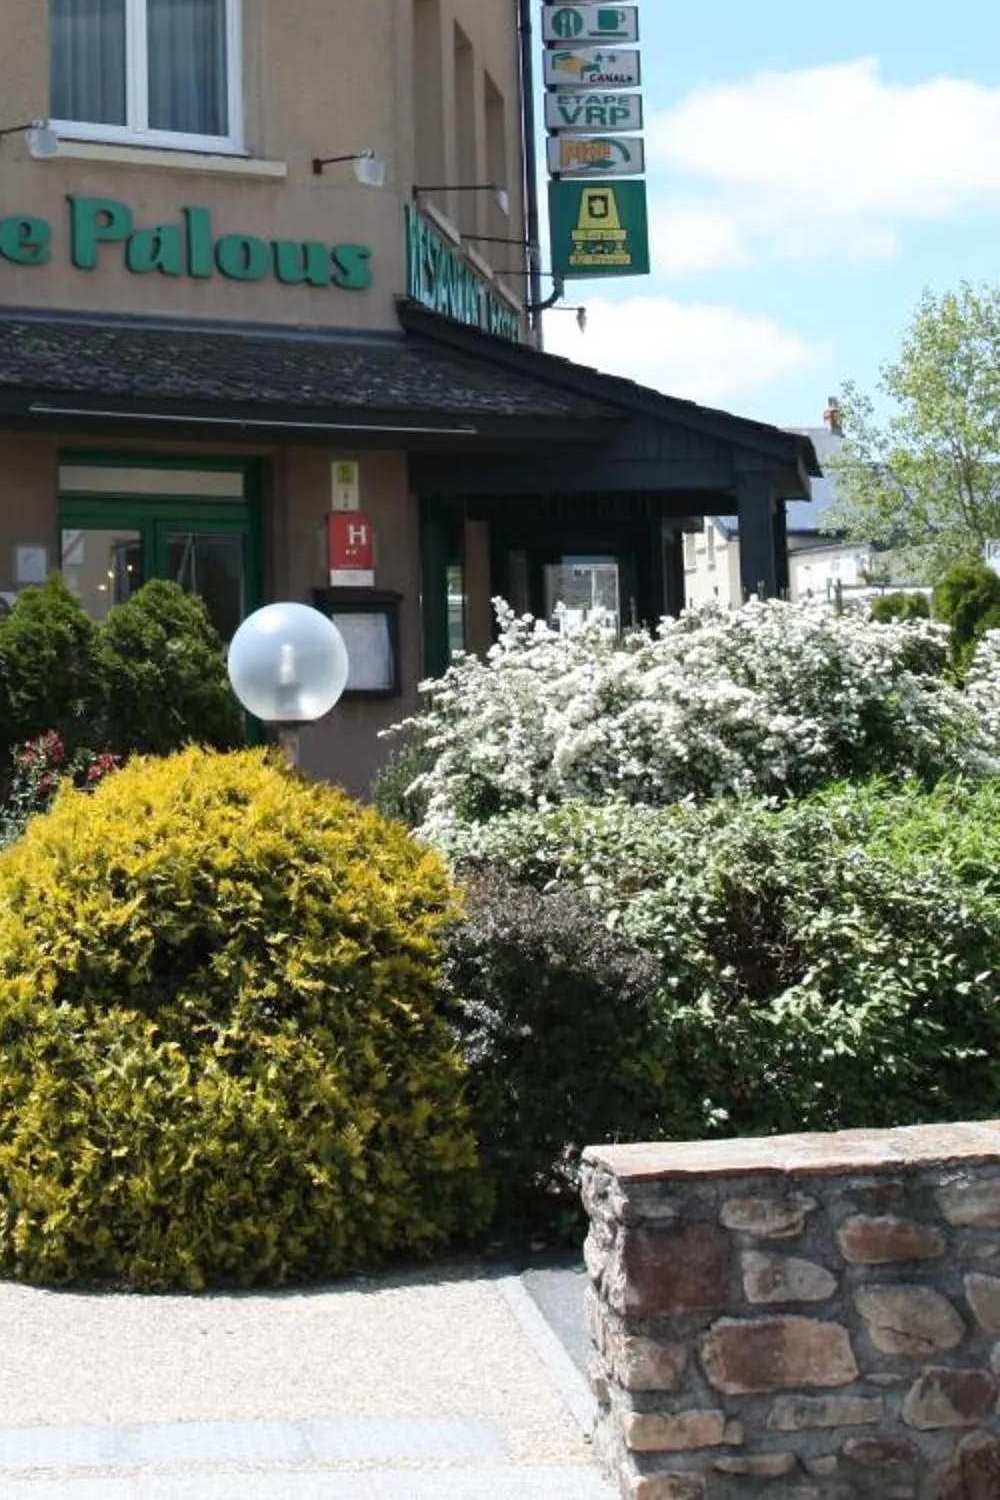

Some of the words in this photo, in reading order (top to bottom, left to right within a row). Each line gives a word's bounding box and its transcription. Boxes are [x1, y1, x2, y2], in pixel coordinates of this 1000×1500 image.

[557, 95, 630, 105] ETAPE
[558, 106, 631, 125] VRP
[65, 193, 374, 291] Palous
[348, 524, 367, 545] H
